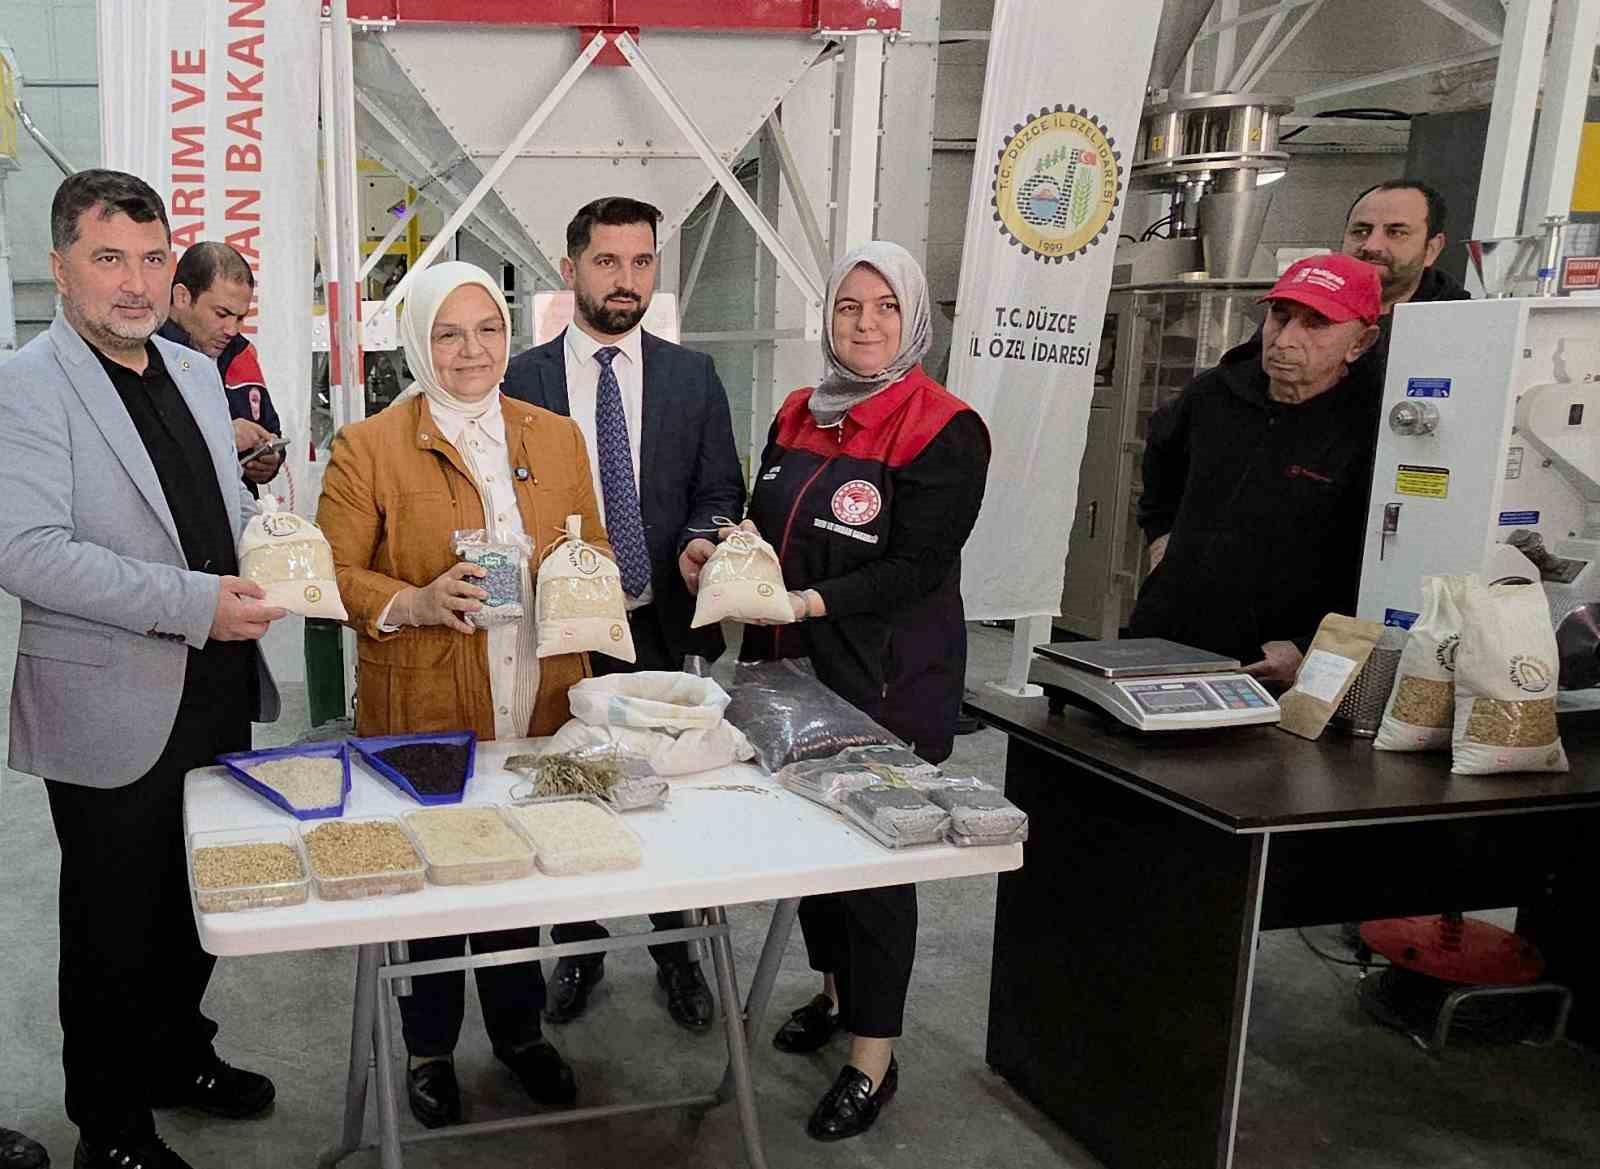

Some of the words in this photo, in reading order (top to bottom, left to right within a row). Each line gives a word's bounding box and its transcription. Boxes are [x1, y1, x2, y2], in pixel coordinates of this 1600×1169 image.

[171, 48, 206, 113] VE
[225, 0, 265, 172] BAKAN
[995, 307, 1022, 328] T.C.
[1025, 306, 1077, 334] DÜZCE
[969, 331, 982, 357] İL
[989, 332, 1026, 360] ÖZEL
[1031, 336, 1092, 367] İDARESİ
